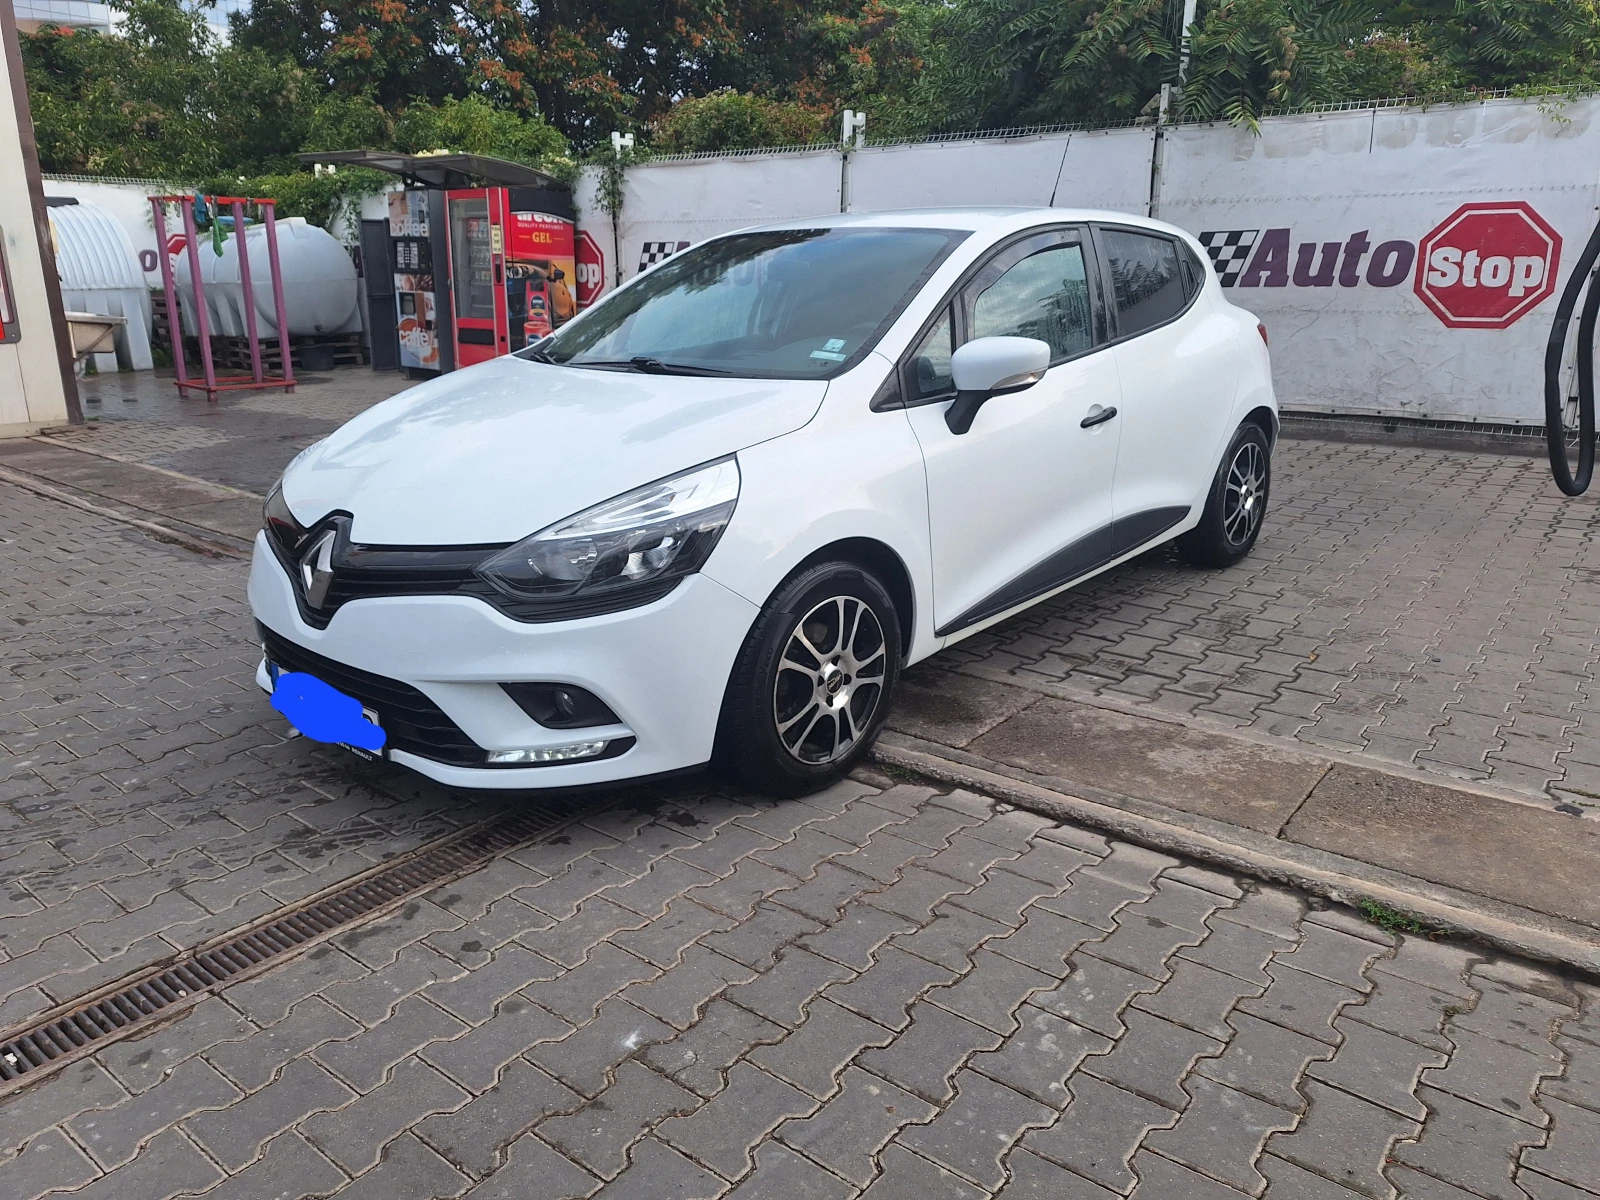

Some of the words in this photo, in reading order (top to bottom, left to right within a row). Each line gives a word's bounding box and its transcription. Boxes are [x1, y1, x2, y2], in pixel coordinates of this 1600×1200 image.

[391, 218, 429, 236] coffee
[517, 221, 538, 229] QUALITY
[539, 223, 564, 231] PERFUMES
[532, 231, 552, 244] GEL
[1239, 228, 1415, 288] Auto
[1427, 246, 1545, 297] Stop
[576, 263, 599, 288] op
